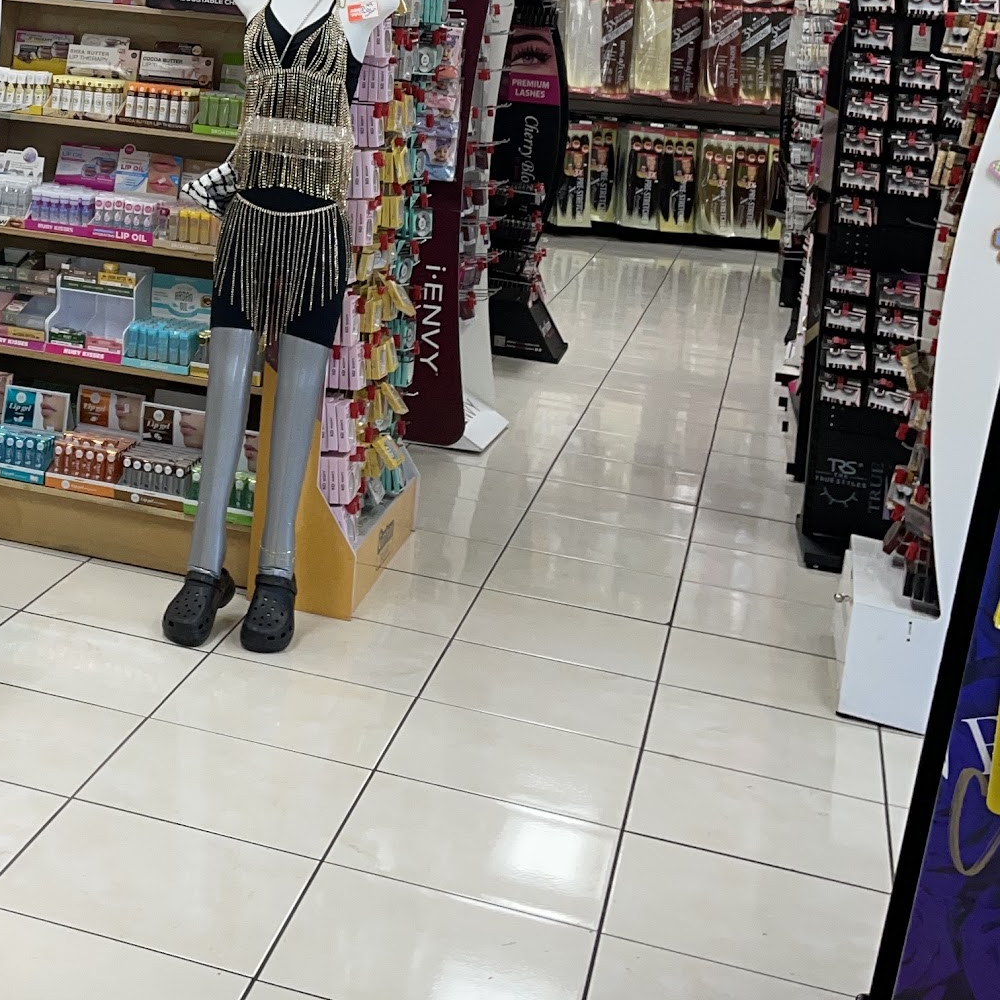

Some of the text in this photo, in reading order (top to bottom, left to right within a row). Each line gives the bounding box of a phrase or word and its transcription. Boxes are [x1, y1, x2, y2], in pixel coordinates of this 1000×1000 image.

[512, 78, 550, 89] PREMIUM
[514, 88, 545, 98] LASHES
[517, 115, 539, 157] Cherry
[115, 231, 147, 243] LIP OIL
